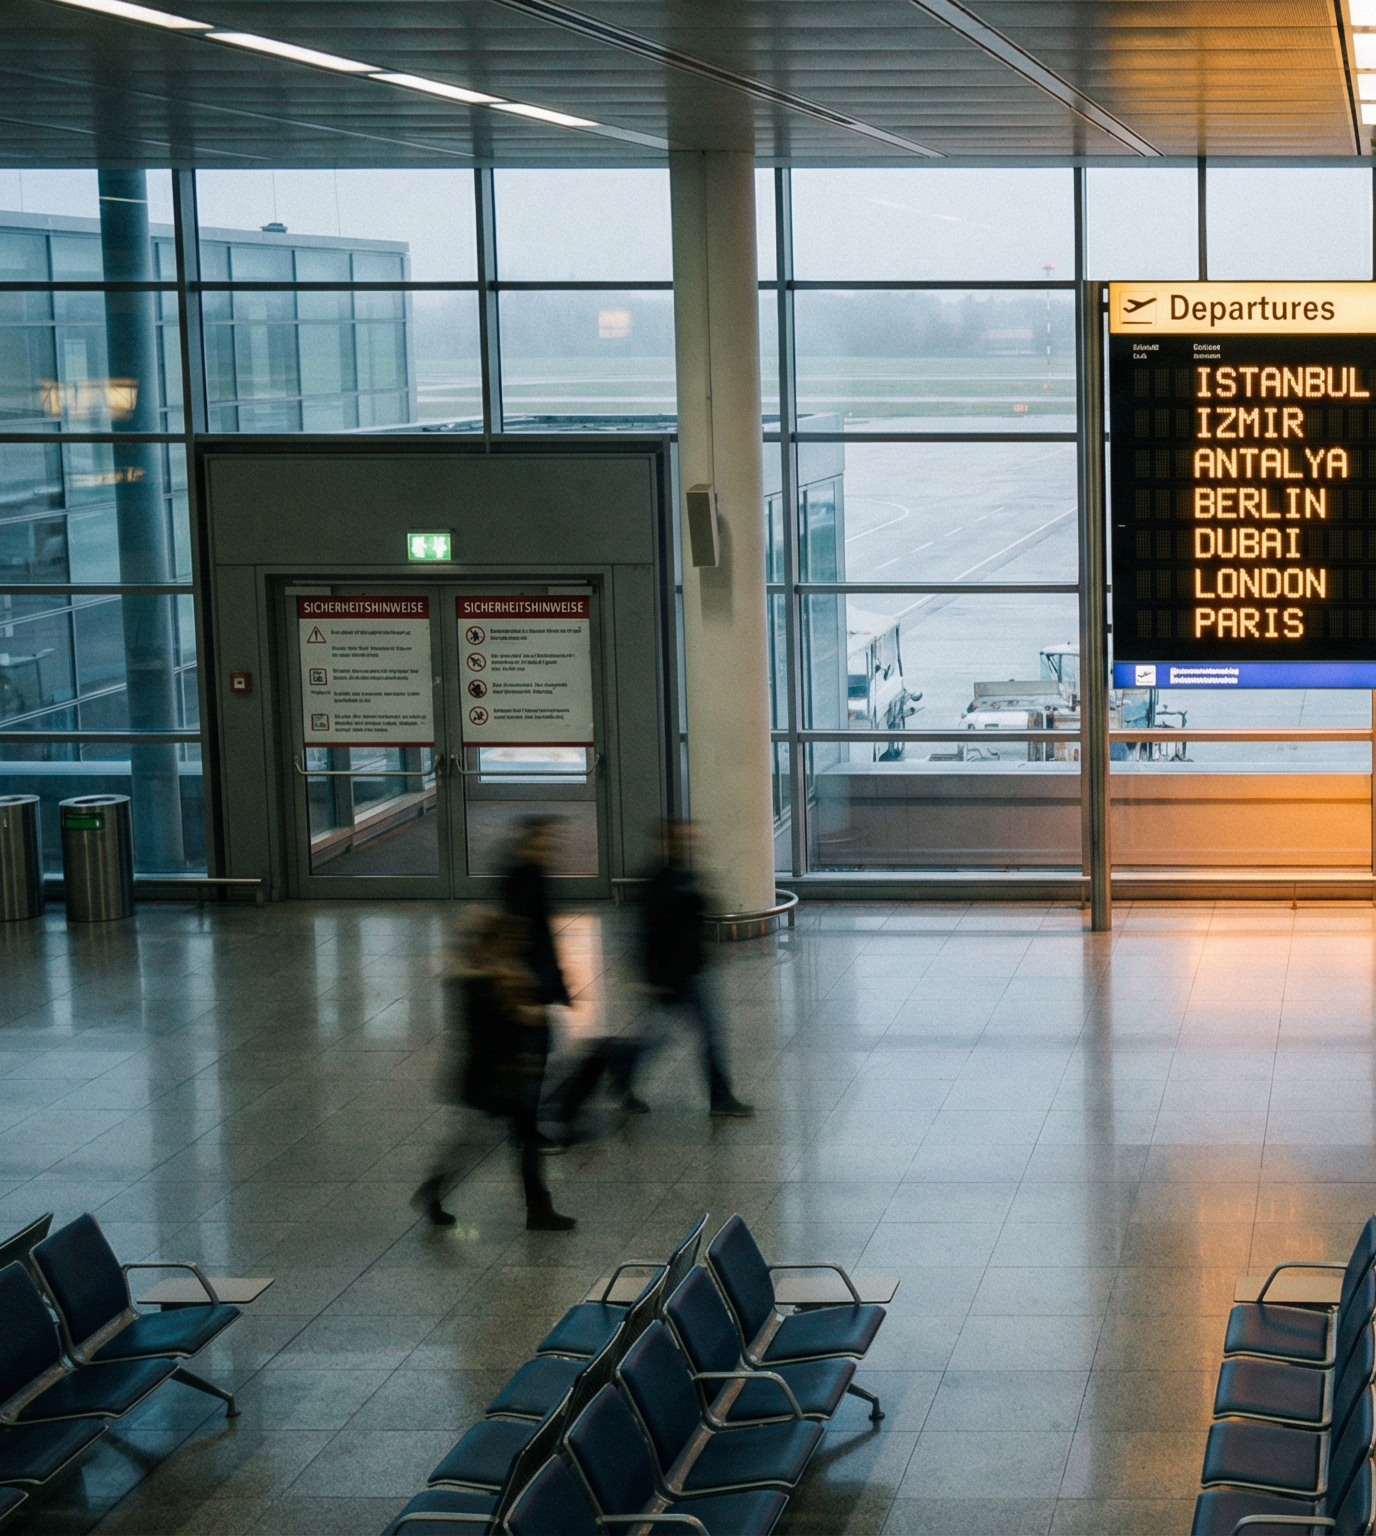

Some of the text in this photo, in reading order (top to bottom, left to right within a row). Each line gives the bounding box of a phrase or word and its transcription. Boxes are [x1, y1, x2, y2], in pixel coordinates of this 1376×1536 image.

[1170, 294, 1336, 328] Departures
[1197, 366, 1370, 398] ISTANBUL
[1197, 407, 1304, 439] IZMIR
[1194, 448, 1349, 479] ANTALYA
[1194, 488, 1327, 519] BERLIN
[1194, 528, 1301, 559] DUBAI
[1195, 568, 1327, 599] LONDON
[303, 601, 424, 614] SICHERHEITSHINWEISE
[1195, 608, 1305, 639] PARIS
